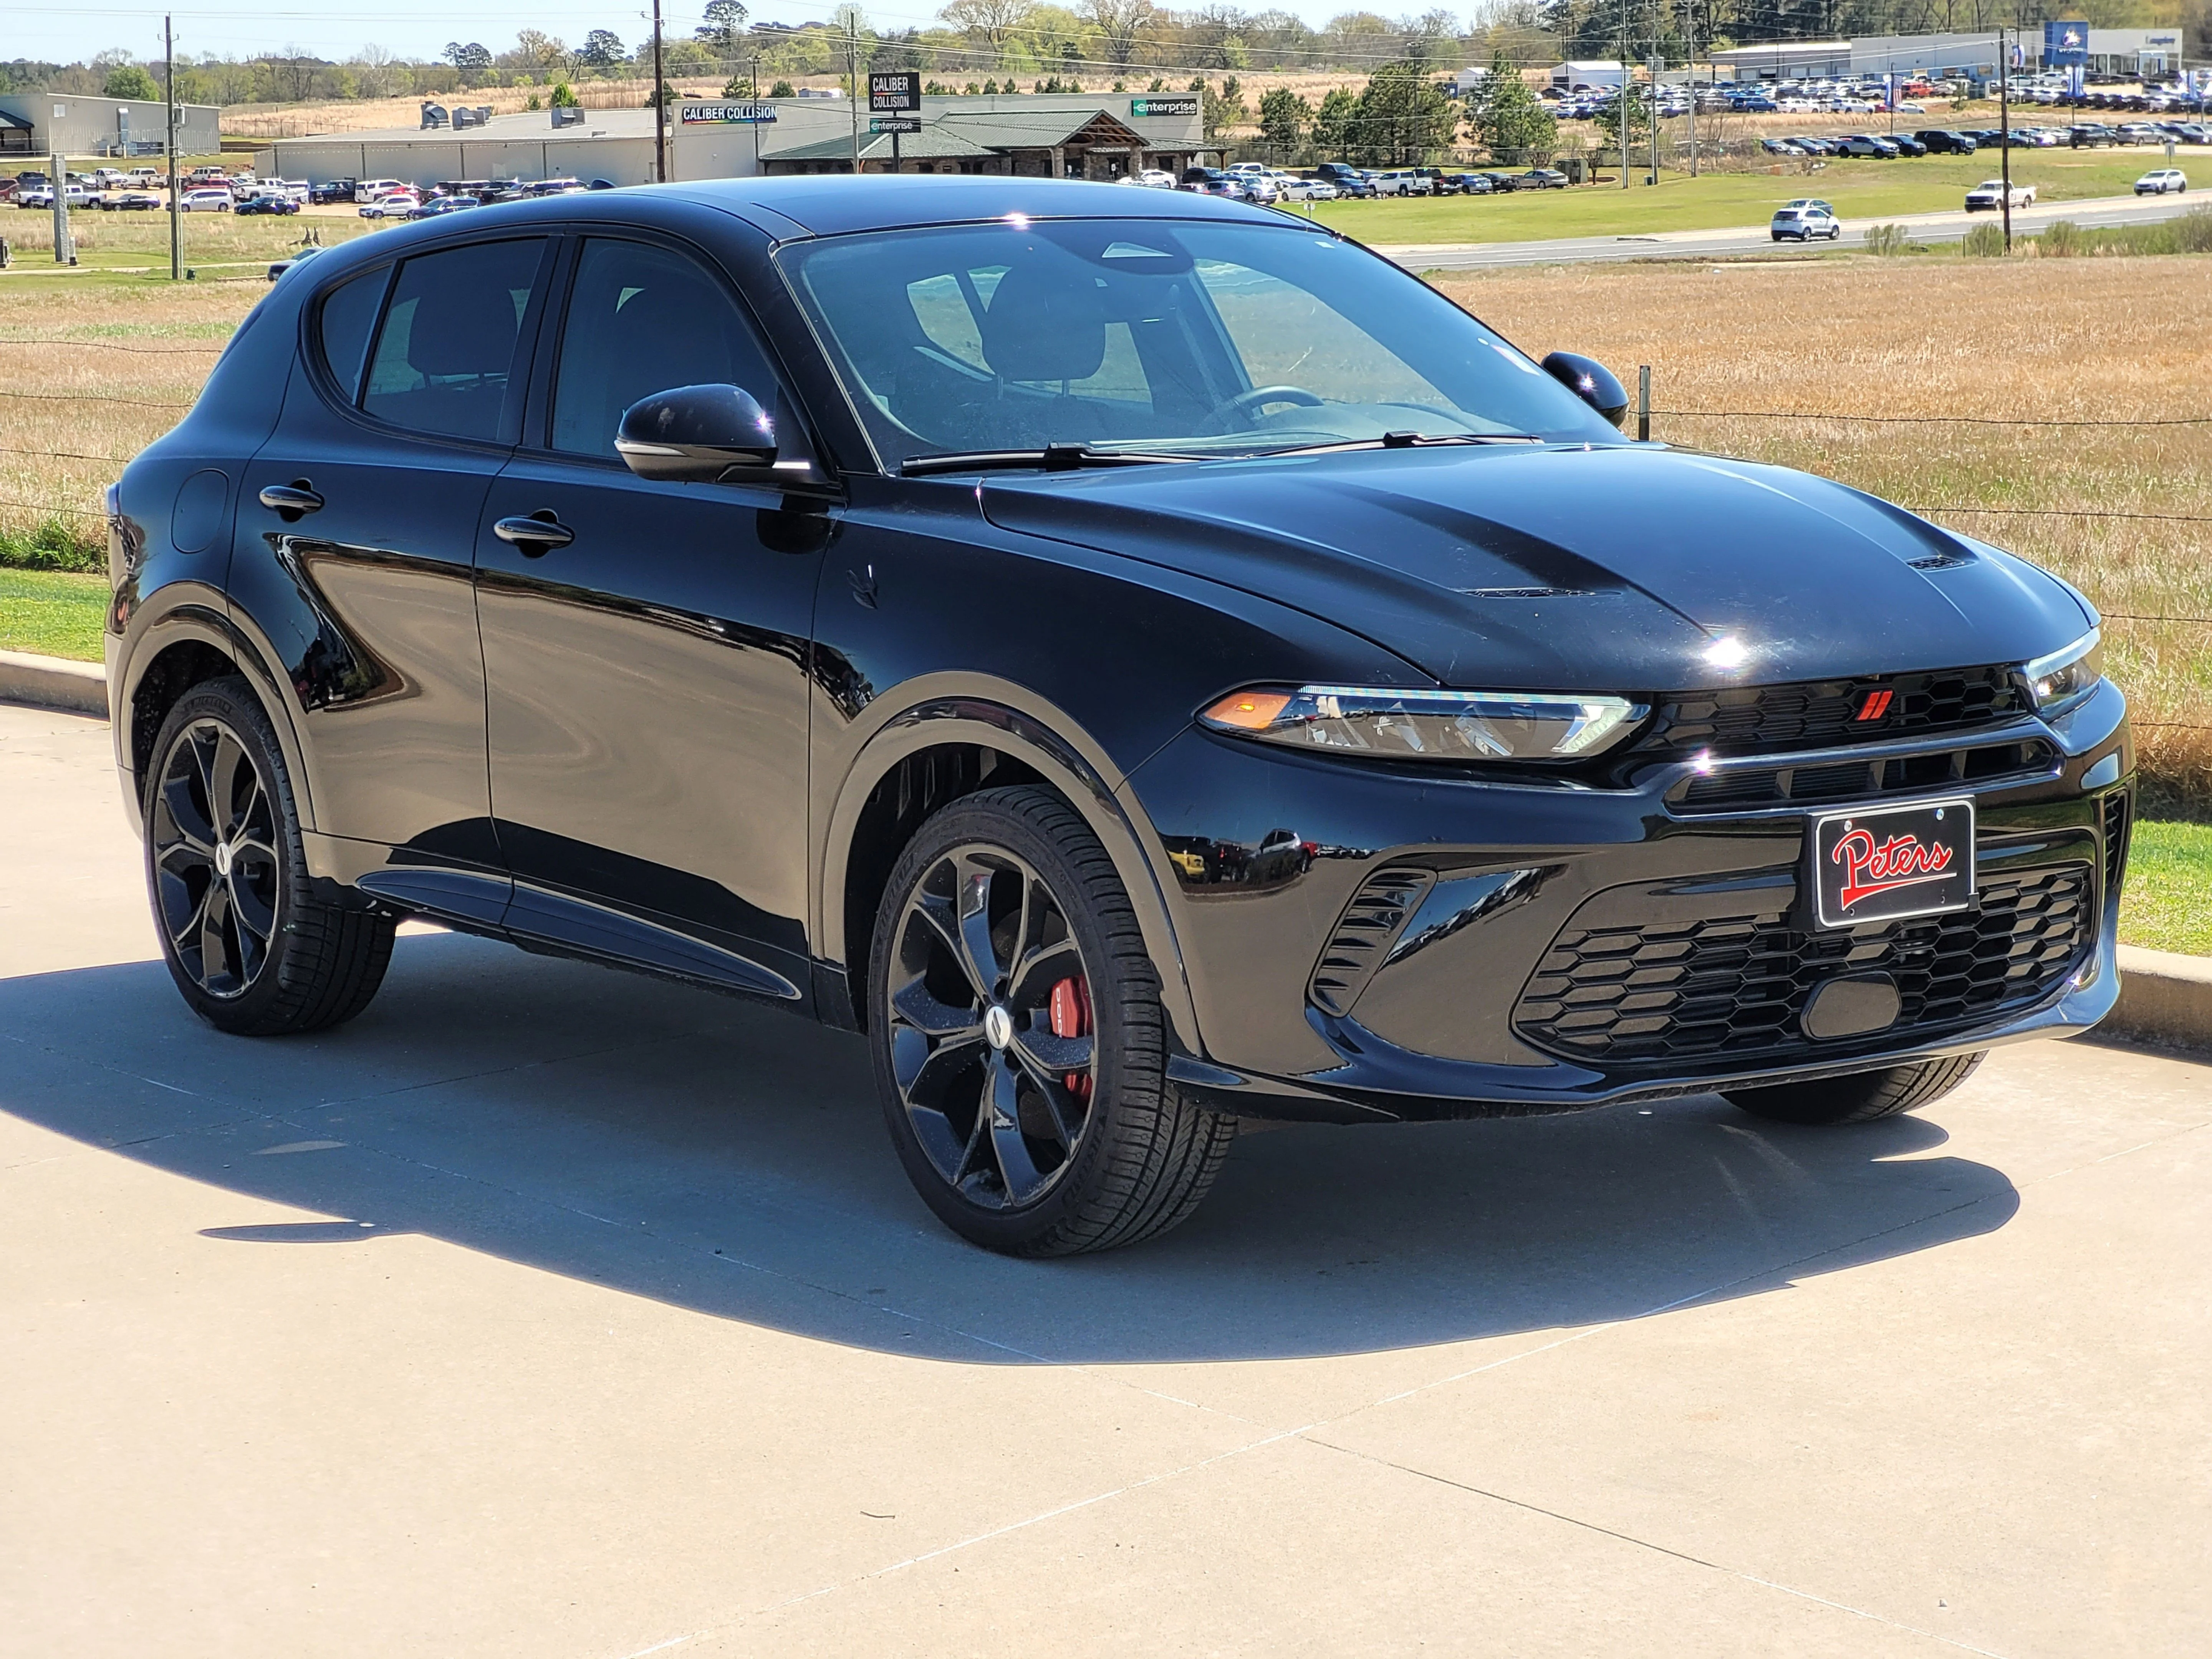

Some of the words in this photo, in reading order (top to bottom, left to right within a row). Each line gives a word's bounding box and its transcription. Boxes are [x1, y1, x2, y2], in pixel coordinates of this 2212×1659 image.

[873, 76, 909, 91] CALIBER
[873, 95, 909, 108] COLLISION
[1136, 101, 1197, 114] enterprise
[683, 107, 725, 120] CALIBER
[727, 106, 777, 119] COLLISION
[871, 121, 913, 132] enterprise
[1831, 828, 1954, 889] Peters
